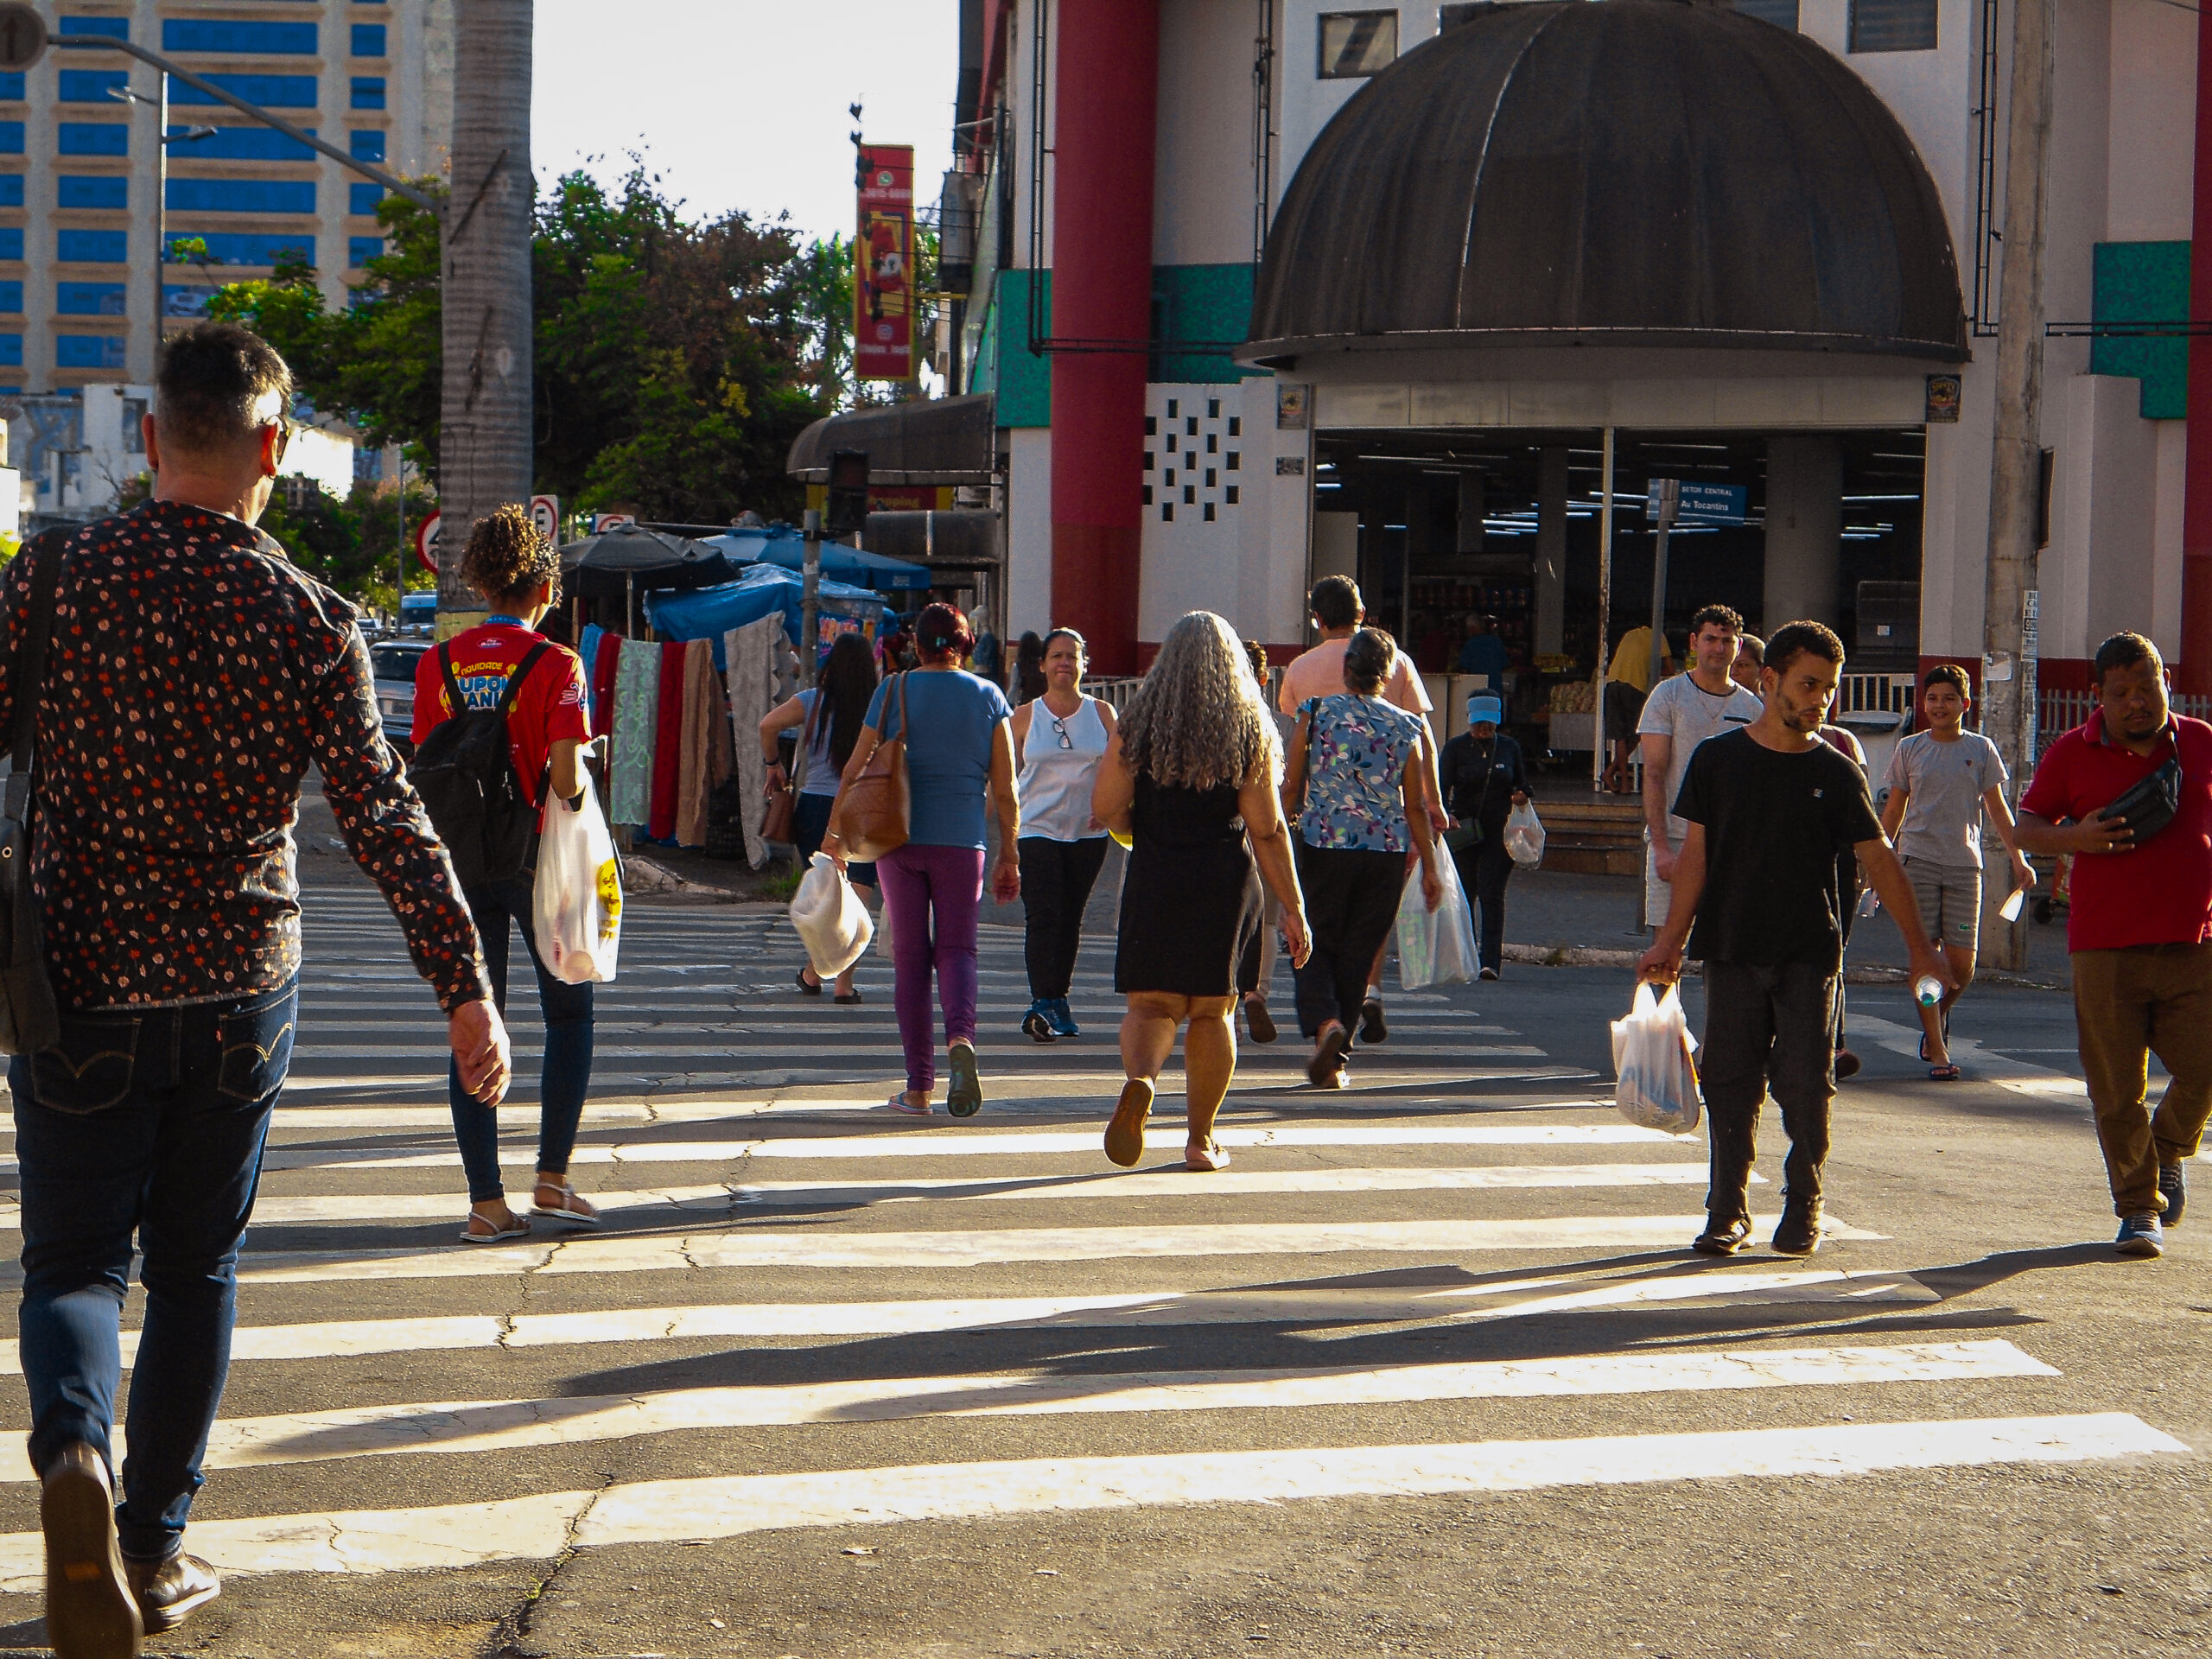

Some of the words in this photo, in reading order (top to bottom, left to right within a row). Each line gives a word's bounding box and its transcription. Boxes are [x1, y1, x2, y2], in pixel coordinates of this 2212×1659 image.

[1705, 487, 1733, 496] CENTRAL
[868, 495, 920, 509] hopping
[1694, 501, 1729, 511] Tocantins
[461, 662, 503, 676] NOVIDADE
[457, 676, 509, 693] UPO
